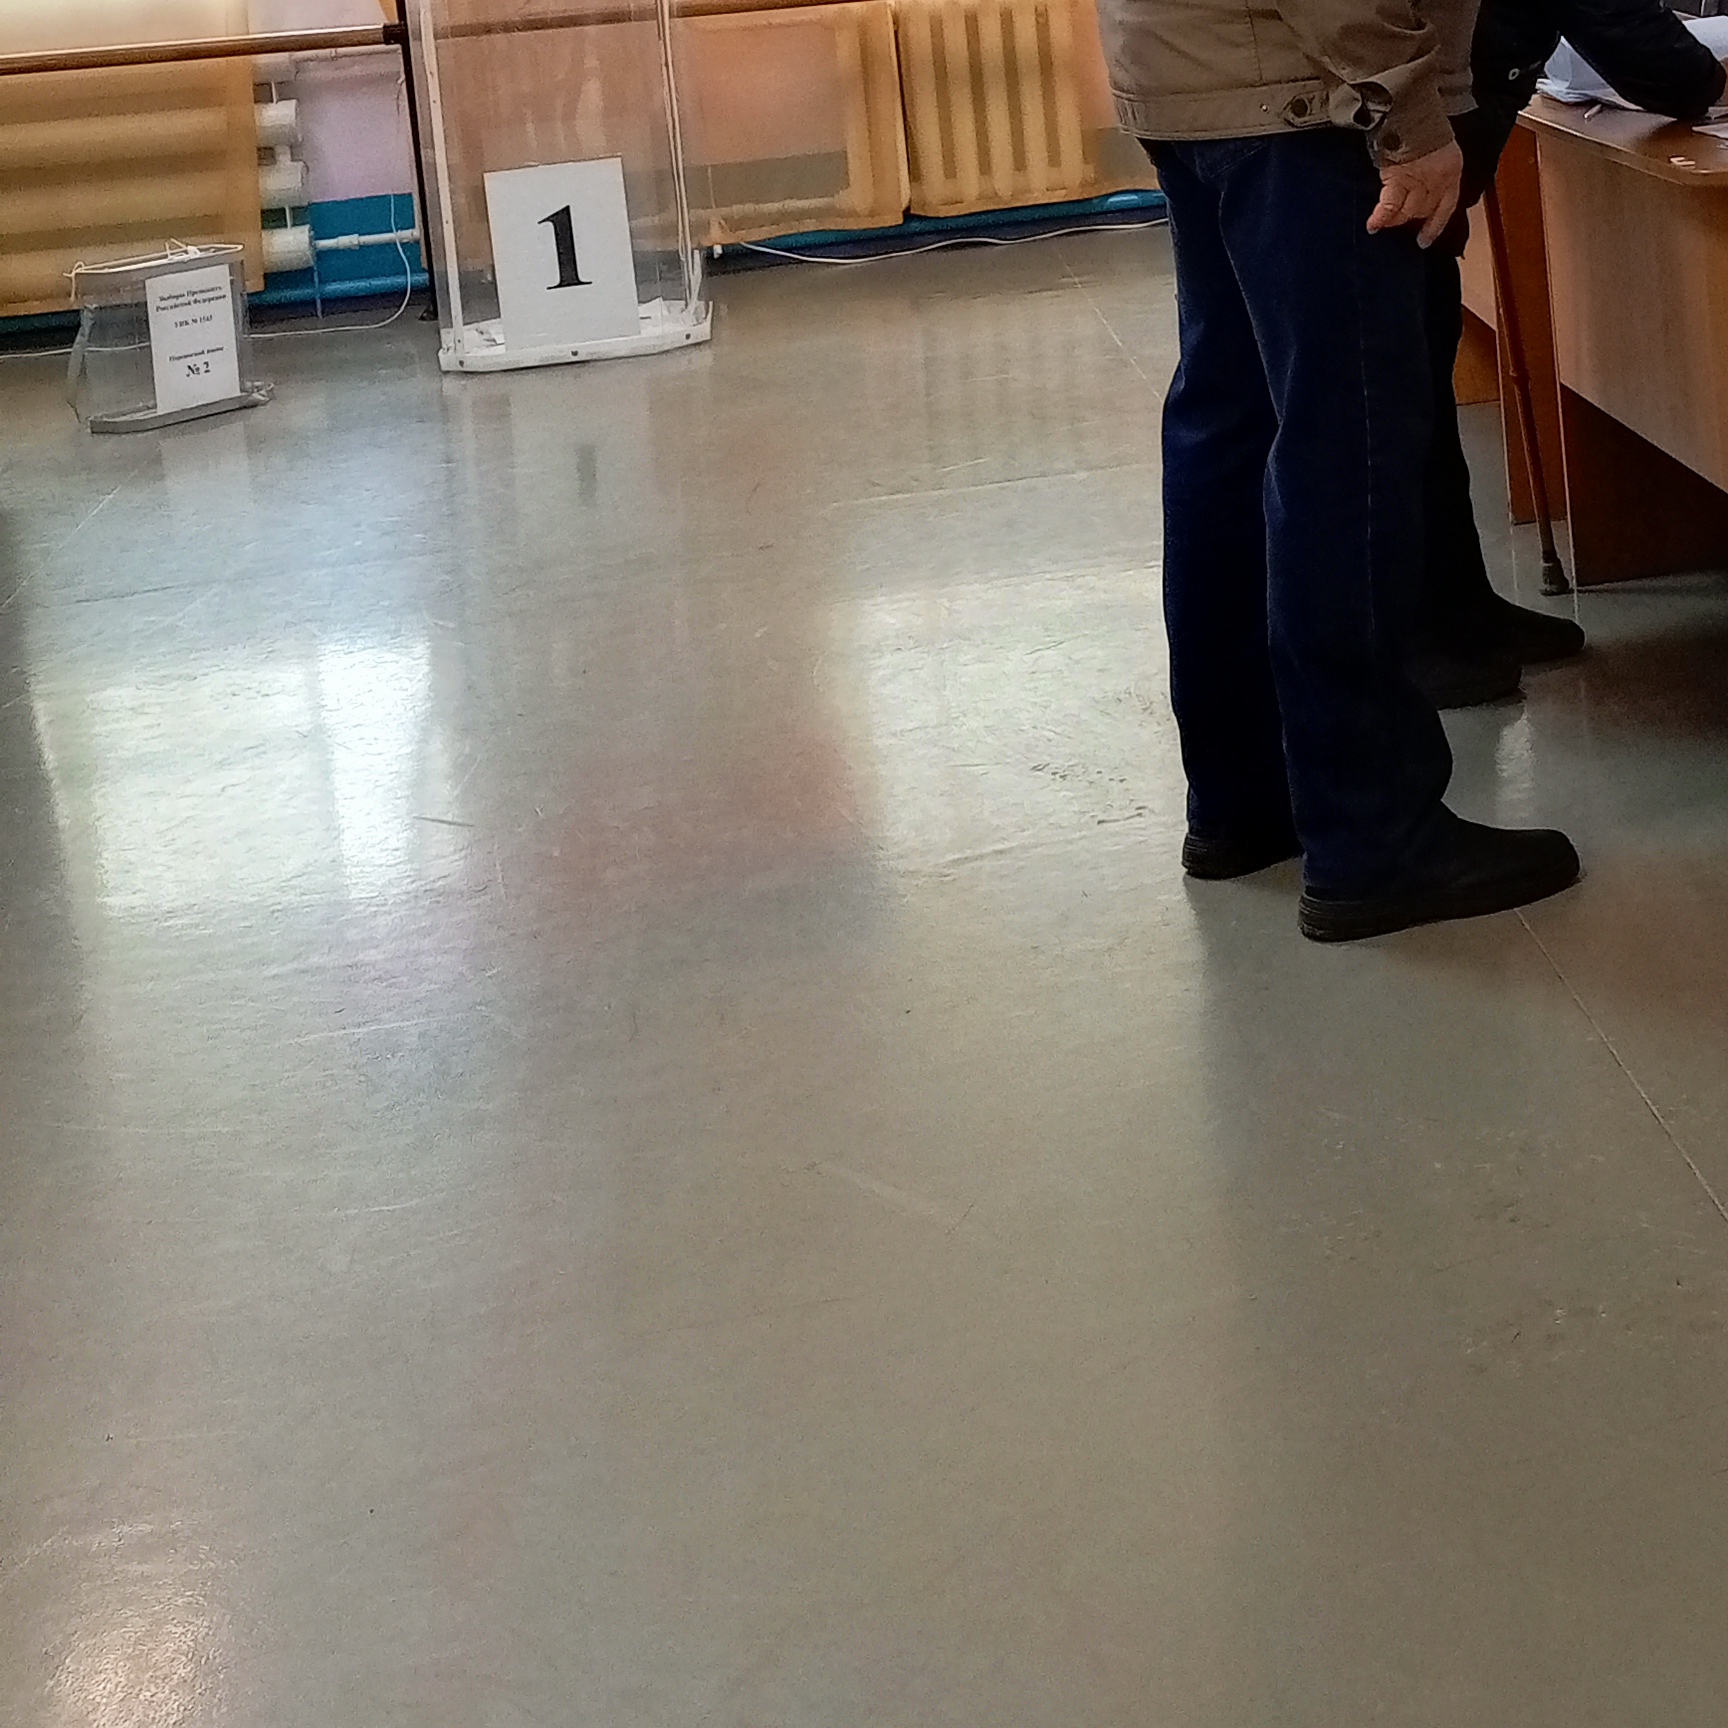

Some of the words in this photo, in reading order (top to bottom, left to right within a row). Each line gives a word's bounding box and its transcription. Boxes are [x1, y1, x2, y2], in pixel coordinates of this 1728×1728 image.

[537, 205, 593, 290] 1
[186, 363, 201, 378] №
[203, 361, 211, 374] 2
